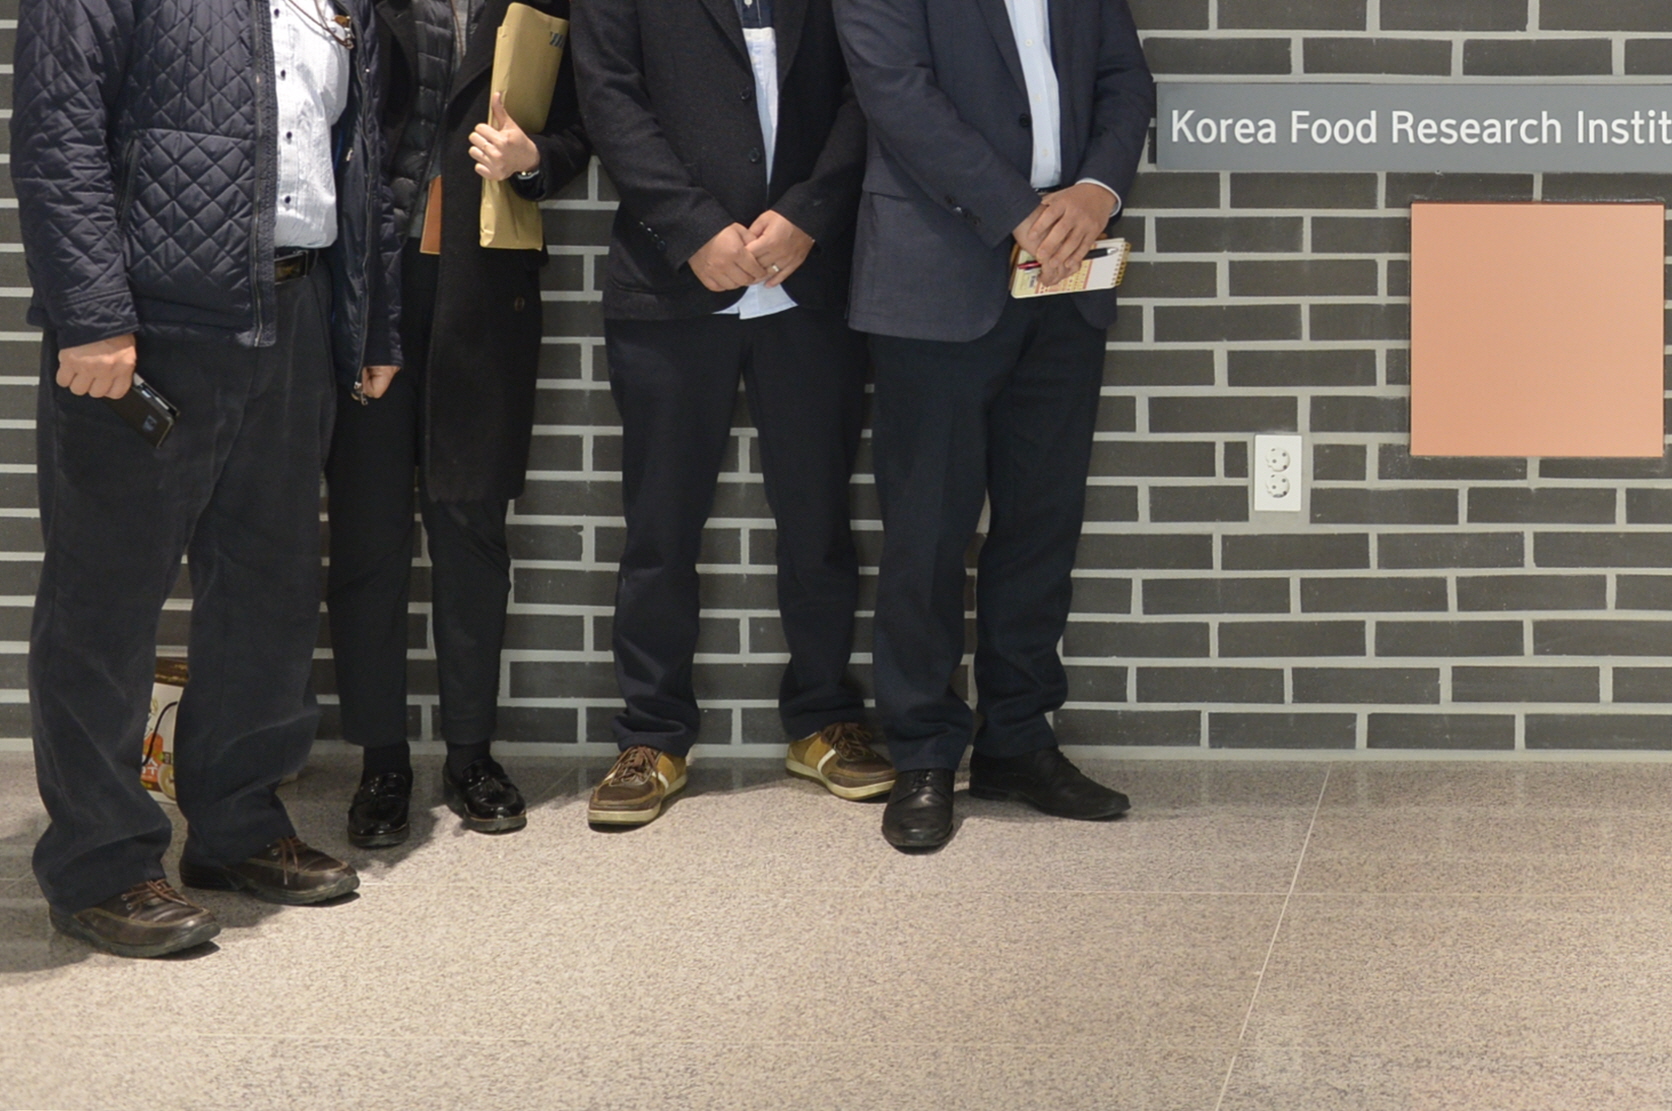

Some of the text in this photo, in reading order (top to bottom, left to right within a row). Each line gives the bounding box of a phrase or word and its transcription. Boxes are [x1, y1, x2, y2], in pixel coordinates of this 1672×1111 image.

[1172, 109, 1277, 144] Korea
[1291, 110, 1377, 145] Food
[1392, 110, 1562, 145] Research
